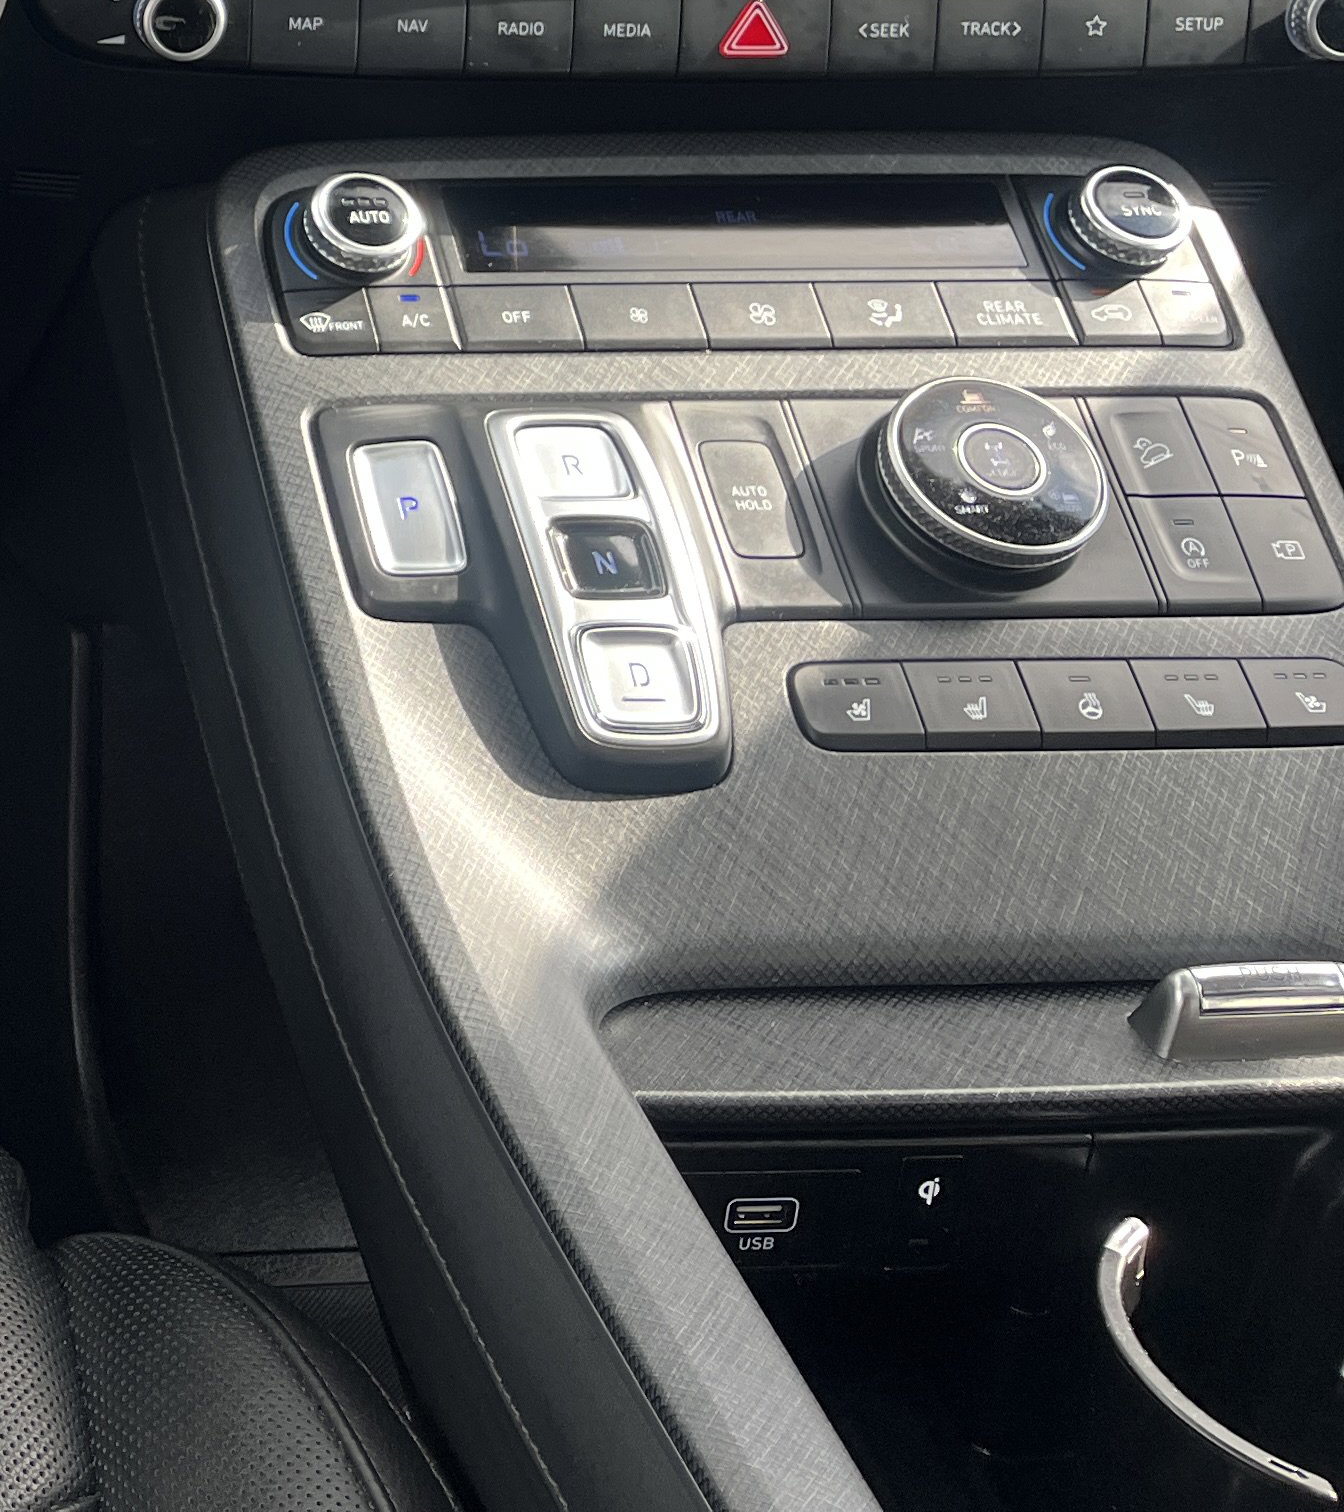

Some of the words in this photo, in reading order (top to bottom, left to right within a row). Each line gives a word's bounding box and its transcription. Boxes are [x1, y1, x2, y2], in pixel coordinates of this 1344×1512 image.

[288, 17, 323, 31] MAP
[397, 19, 429, 33] NAV
[497, 21, 545, 36] RADIO
[603, 23, 652, 38] MEDIA
[1175, 16, 1224, 32] SETUP
[348, 210, 391, 224] AUTO
[1120, 206, 1163, 218] SYNC
[982, 300, 1027, 314] REAR
[401, 313, 431, 328] A/C
[501, 310, 531, 324] OFF
[976, 311, 1044, 327] CLIMATE
[328, 320, 363, 332] FRONT
[562, 454, 584, 476] R
[730, 484, 768, 498] AUTO
[396, 496, 419, 521] P
[735, 498, 773, 512] HOLD
[591, 550, 619, 576] N
[1187, 558, 1210, 569] OFF
[628, 662, 650, 688] D
[738, 1237, 775, 1251] USB
